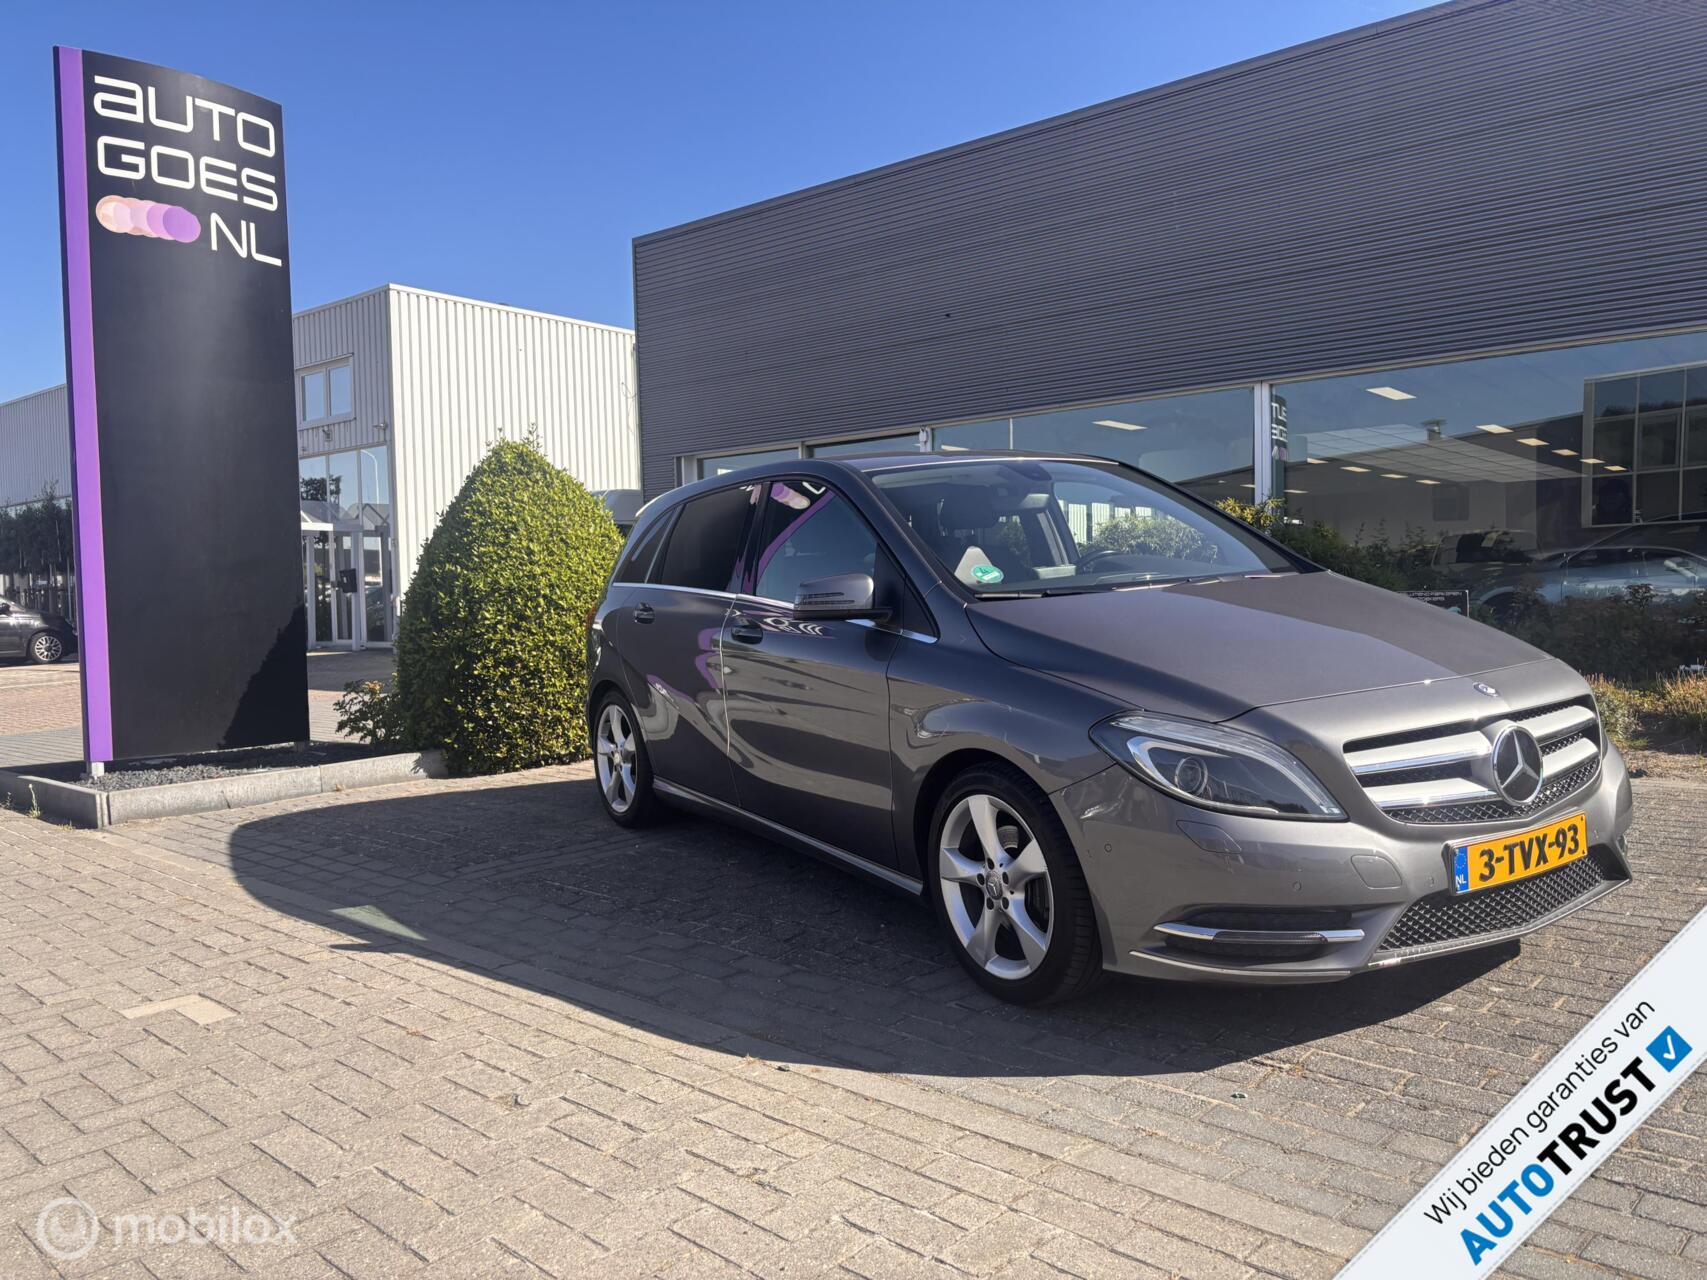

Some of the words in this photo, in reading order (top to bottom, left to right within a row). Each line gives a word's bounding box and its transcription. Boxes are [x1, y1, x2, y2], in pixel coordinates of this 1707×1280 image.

[97, 136, 278, 211] GOES
[210, 212, 282, 266] NL
[1455, 875, 1467, 885] NL
[1479, 823, 1579, 882] 3-TVX-93
